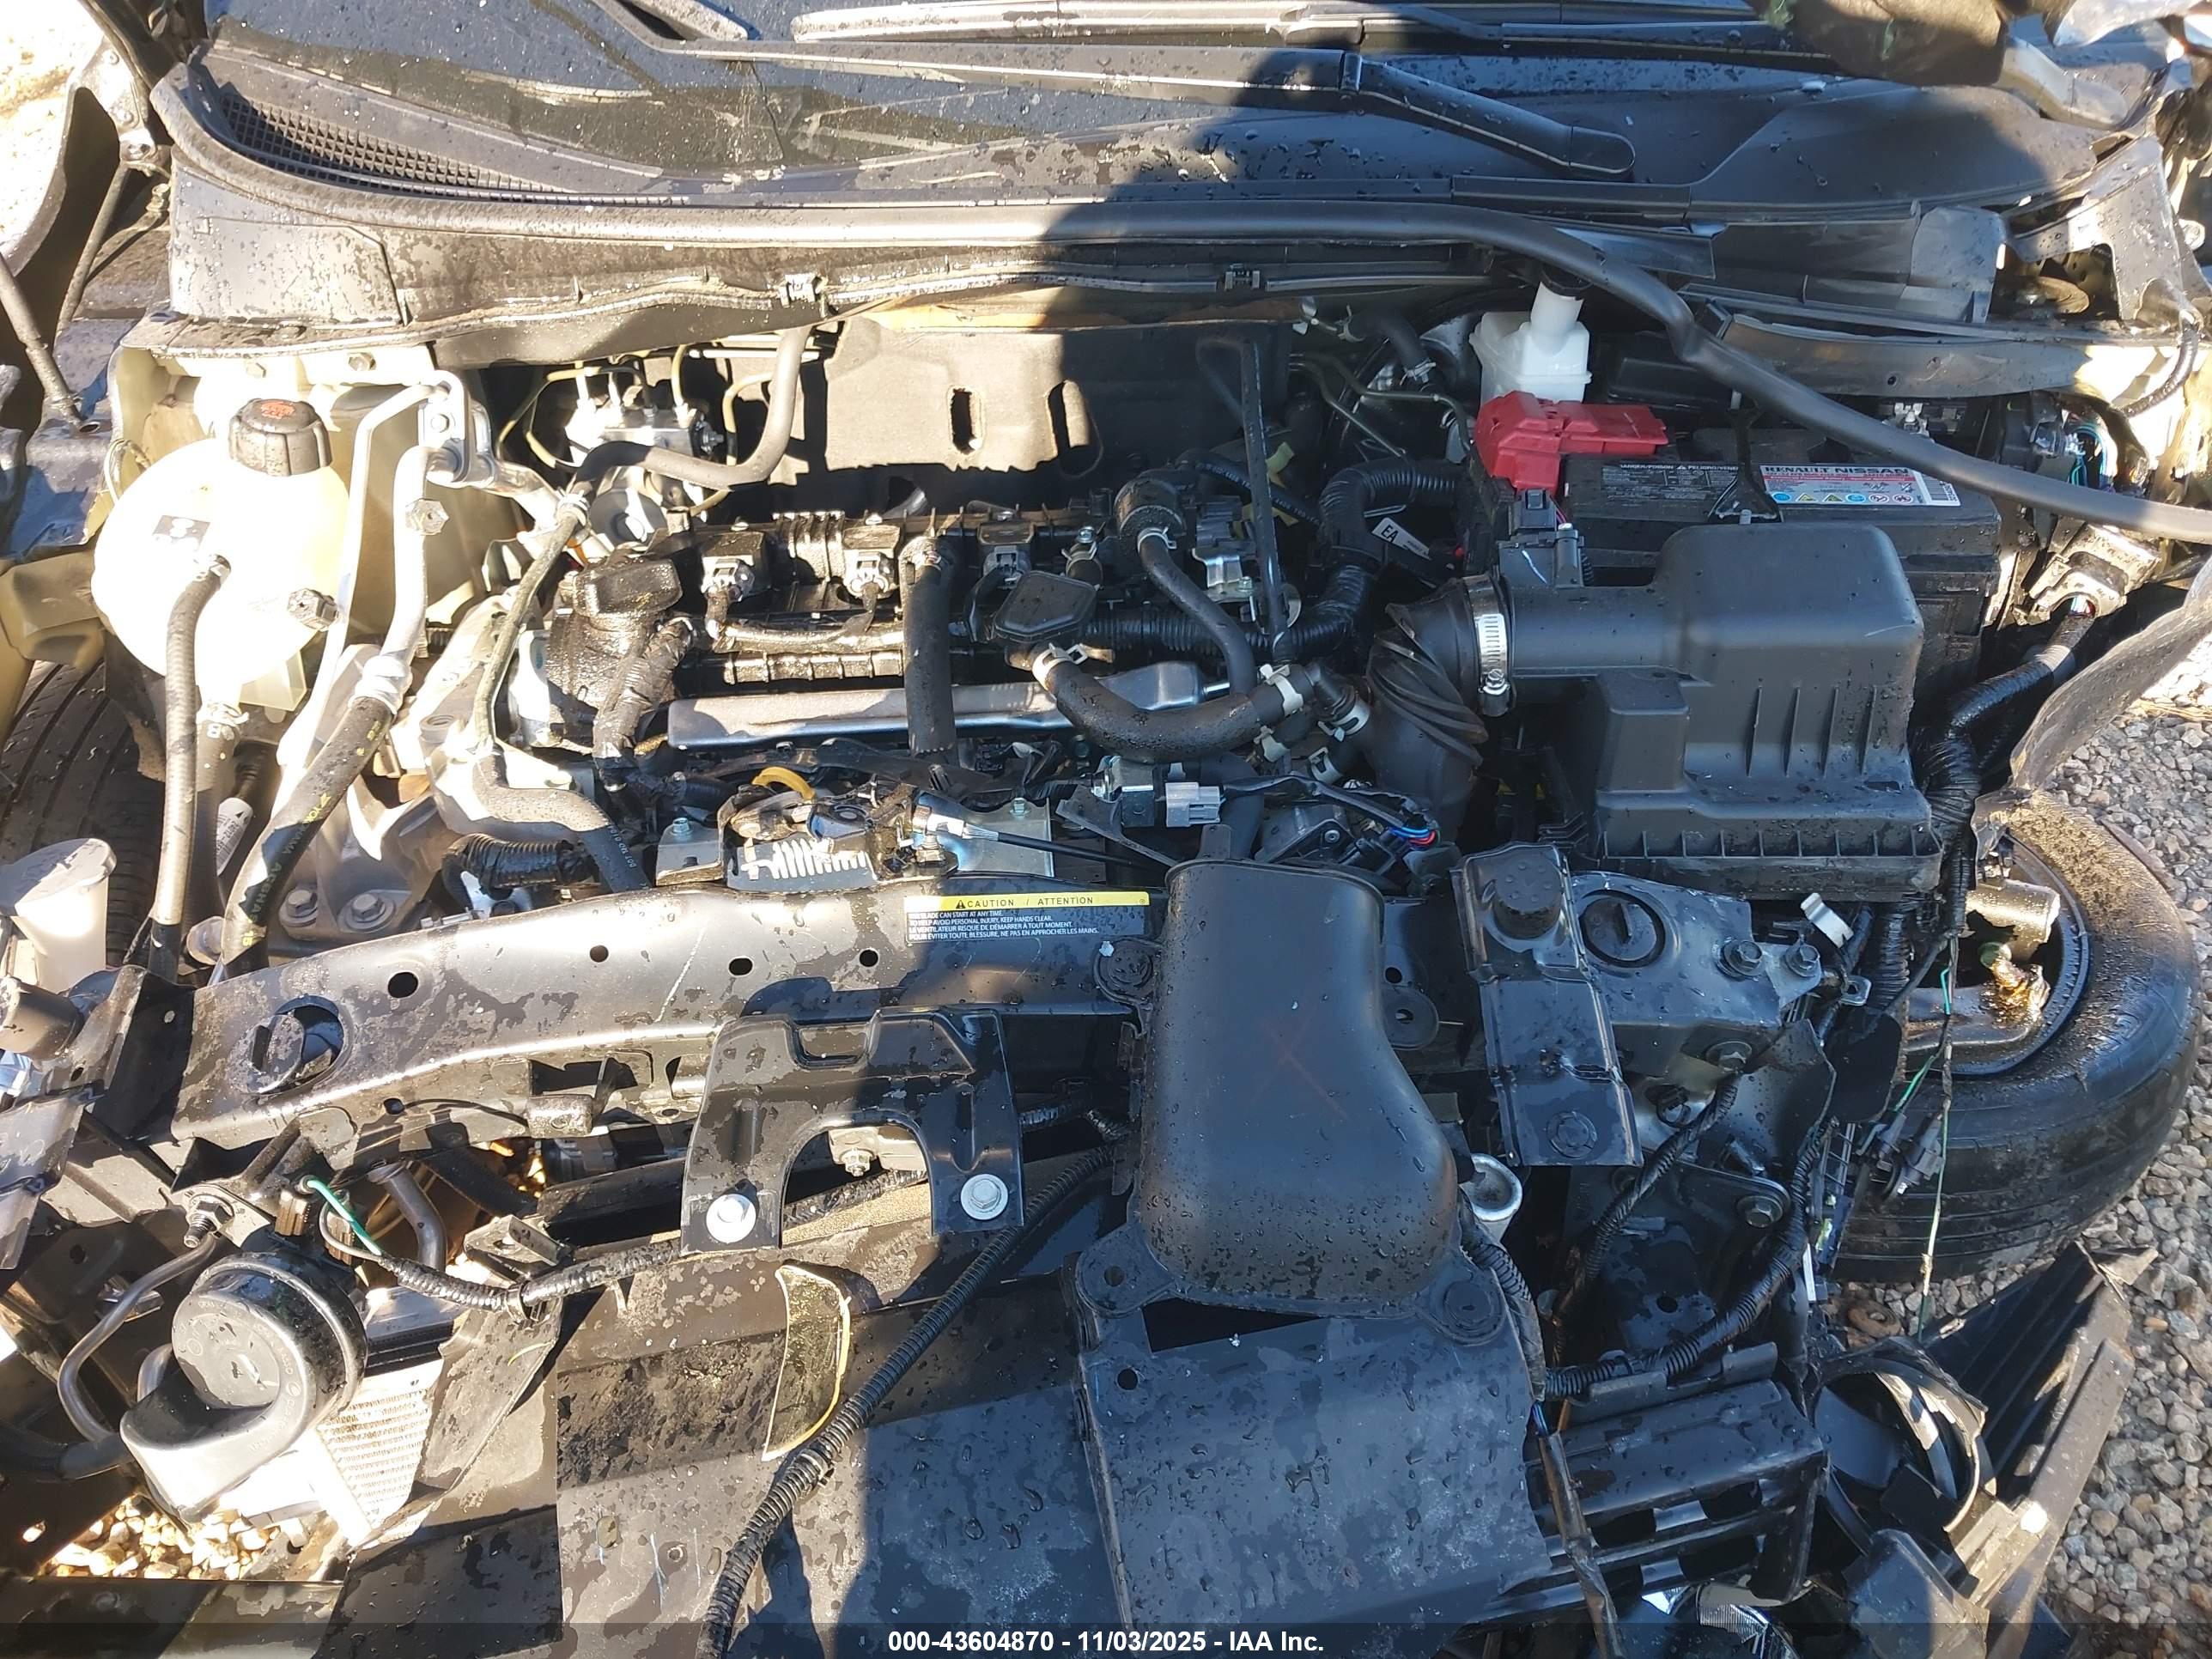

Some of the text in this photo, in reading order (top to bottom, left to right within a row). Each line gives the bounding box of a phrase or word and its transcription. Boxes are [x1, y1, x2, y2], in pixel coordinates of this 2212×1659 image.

[1381, 524, 1399, 543] EA
[967, 899, 1014, 908] CAUTION
[1037, 896, 1093, 906] ATTENTION
[916, 925, 957, 933] VENTILATEUR
